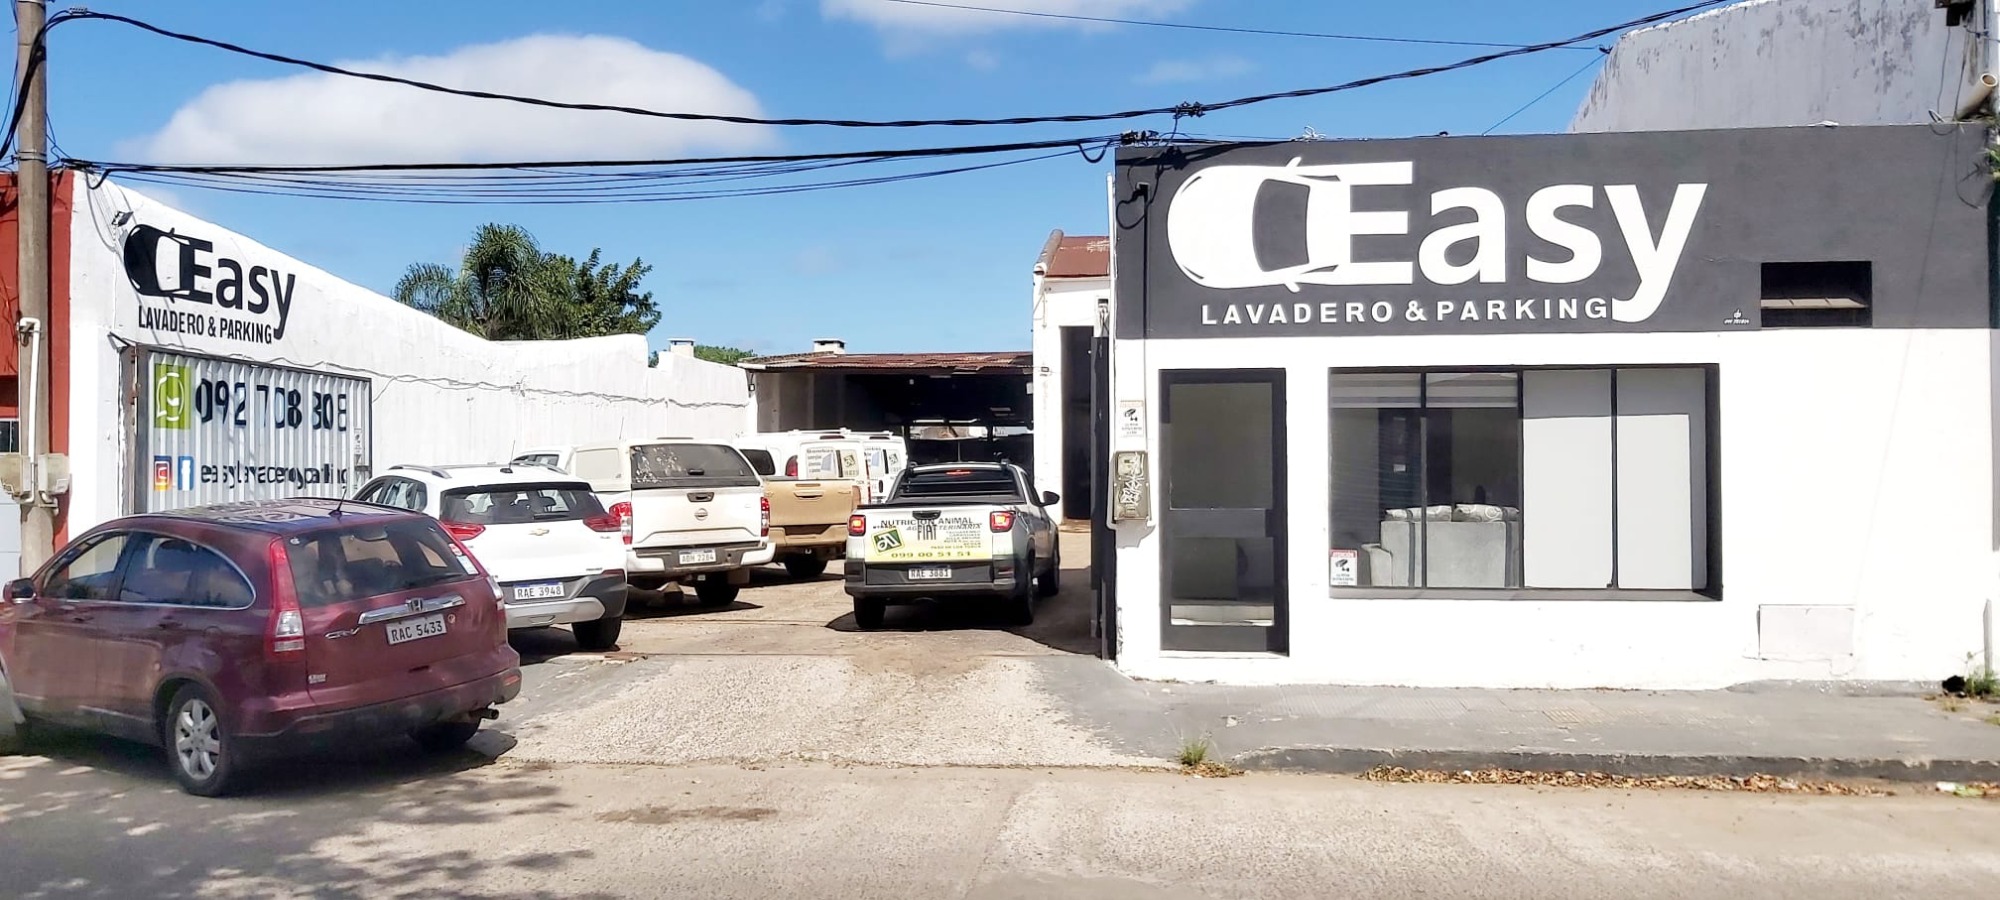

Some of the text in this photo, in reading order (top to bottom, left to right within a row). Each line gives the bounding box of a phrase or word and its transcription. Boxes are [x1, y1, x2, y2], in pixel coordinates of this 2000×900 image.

[1308, 160, 1708, 323] Easy
[180, 235, 296, 340] Easy
[138, 305, 272, 345] LAVADERO & PARKING
[1201, 297, 1607, 325] LAVADERO & PARKING
[195, 378, 247, 426] 092
[256, 384, 303, 430] 708
[917, 524, 937, 541] FIAT
[517, 585, 562, 598] RAE 3948
[391, 620, 443, 642] RAC 5433
